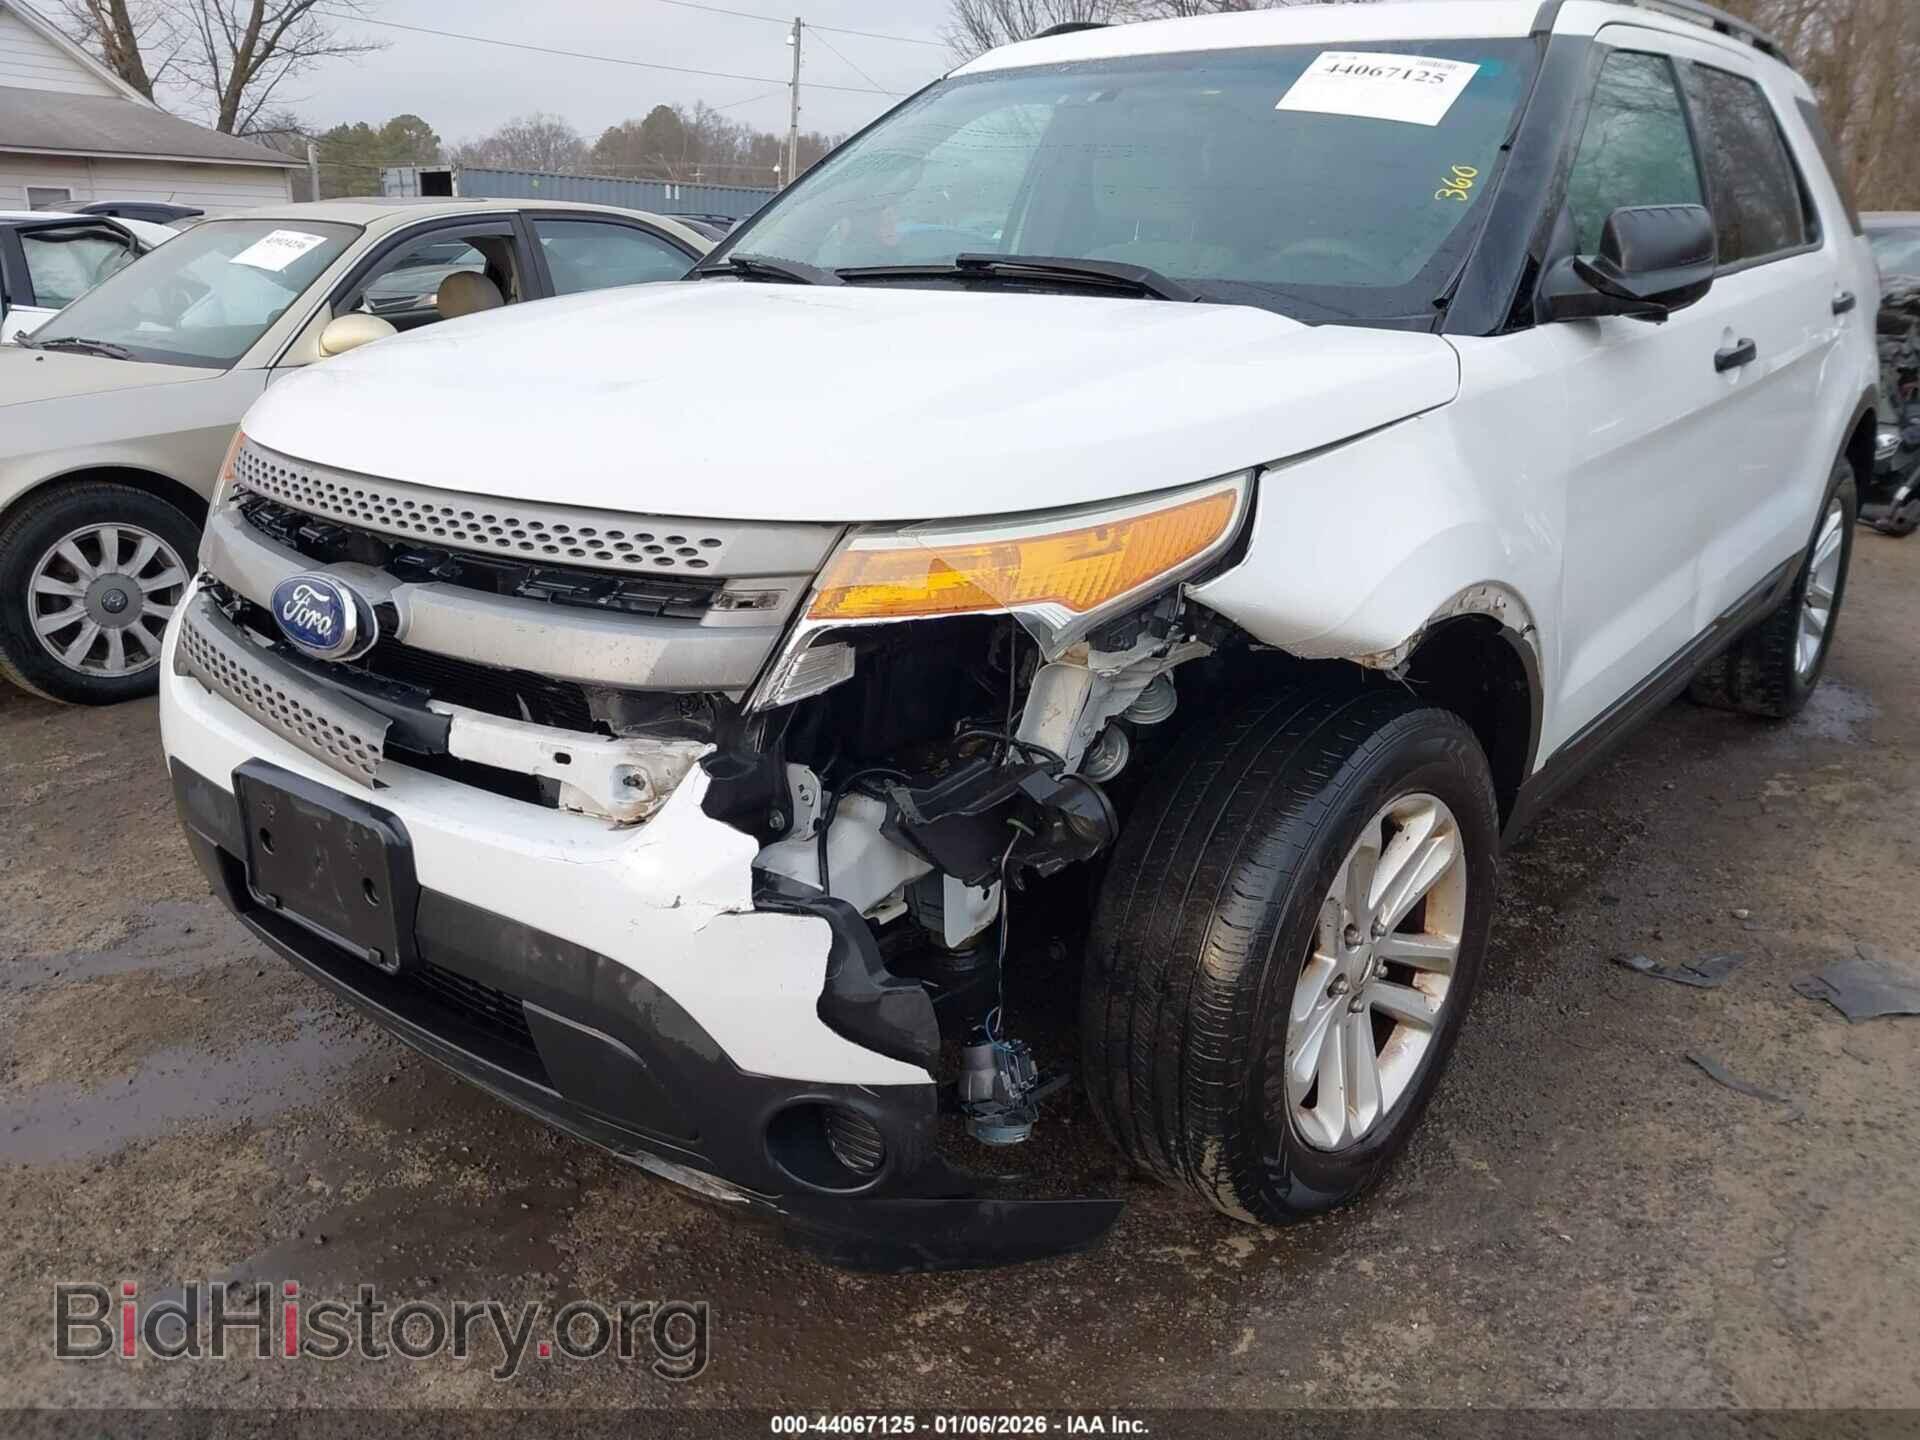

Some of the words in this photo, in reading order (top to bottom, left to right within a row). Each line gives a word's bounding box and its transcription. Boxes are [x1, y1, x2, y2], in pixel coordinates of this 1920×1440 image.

[1323, 62, 1449, 85] 44067125
[1434, 164, 1479, 201] 360
[283, 584, 335, 637] Ford
